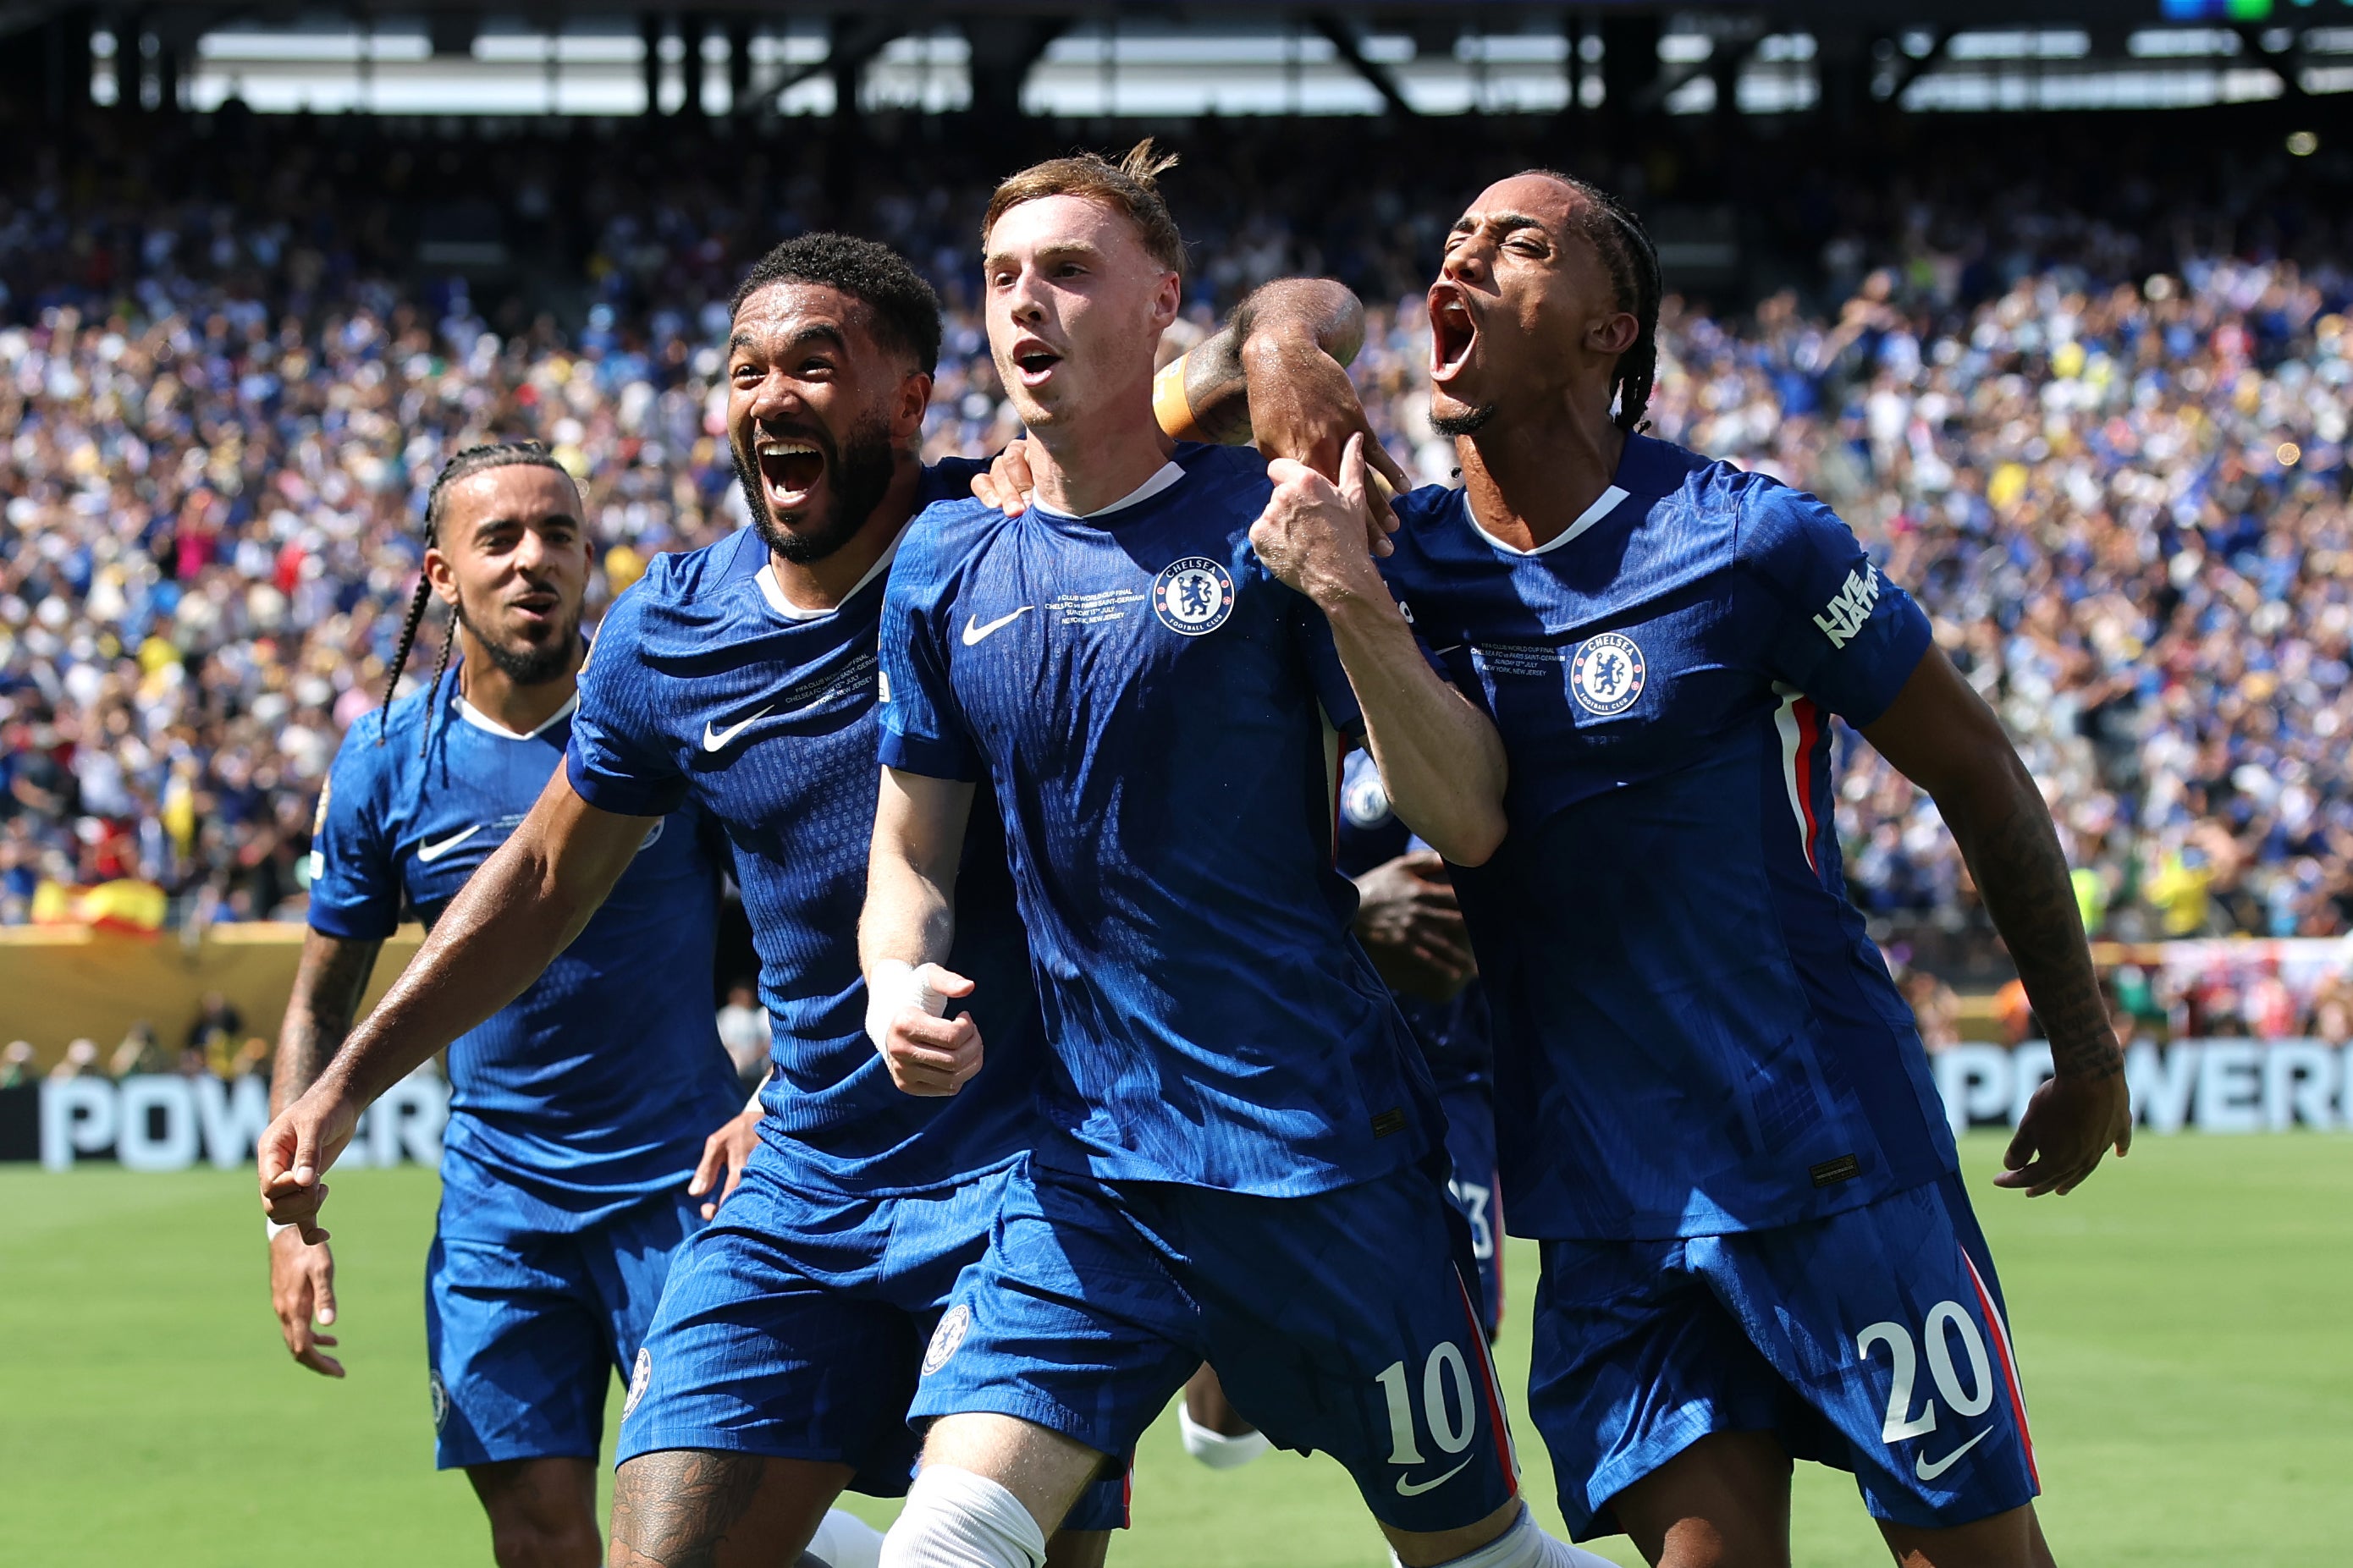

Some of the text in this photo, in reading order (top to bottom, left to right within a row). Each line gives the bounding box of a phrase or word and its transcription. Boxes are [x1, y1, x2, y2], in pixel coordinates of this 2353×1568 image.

[1165, 559, 1216, 578] CHELSEA
[1098, 594, 1145, 607] SAINT-GERMAIN
[1812, 568, 1865, 634] LIVE
[1088, 615, 1103, 624] NEW
[1103, 612, 1125, 621] JERSEY
[1169, 613, 1223, 631] FOOTBALL CLUB
[1470, 647, 1495, 657] CHELSEA
[1524, 653, 1566, 662] SAINT-GERMAIN
[1588, 635, 1635, 657] CHELSEA
[807, 679, 825, 689] CLUB
[852, 652, 869, 665] FINAL
[846, 674, 860, 685] JULY
[785, 690, 813, 704] CHELSEA
[813, 686, 822, 695] FC
[836, 686, 851, 696] NEW
[851, 675, 873, 690] JERSEY
[1579, 692, 1628, 711] FOOTBALL CLUB
[1935, 1037, 2353, 1135] PWER
[1448, 1178, 1494, 1260] 3
[1856, 1300, 1993, 1444] 20
[1375, 1340, 1475, 1465] 10
